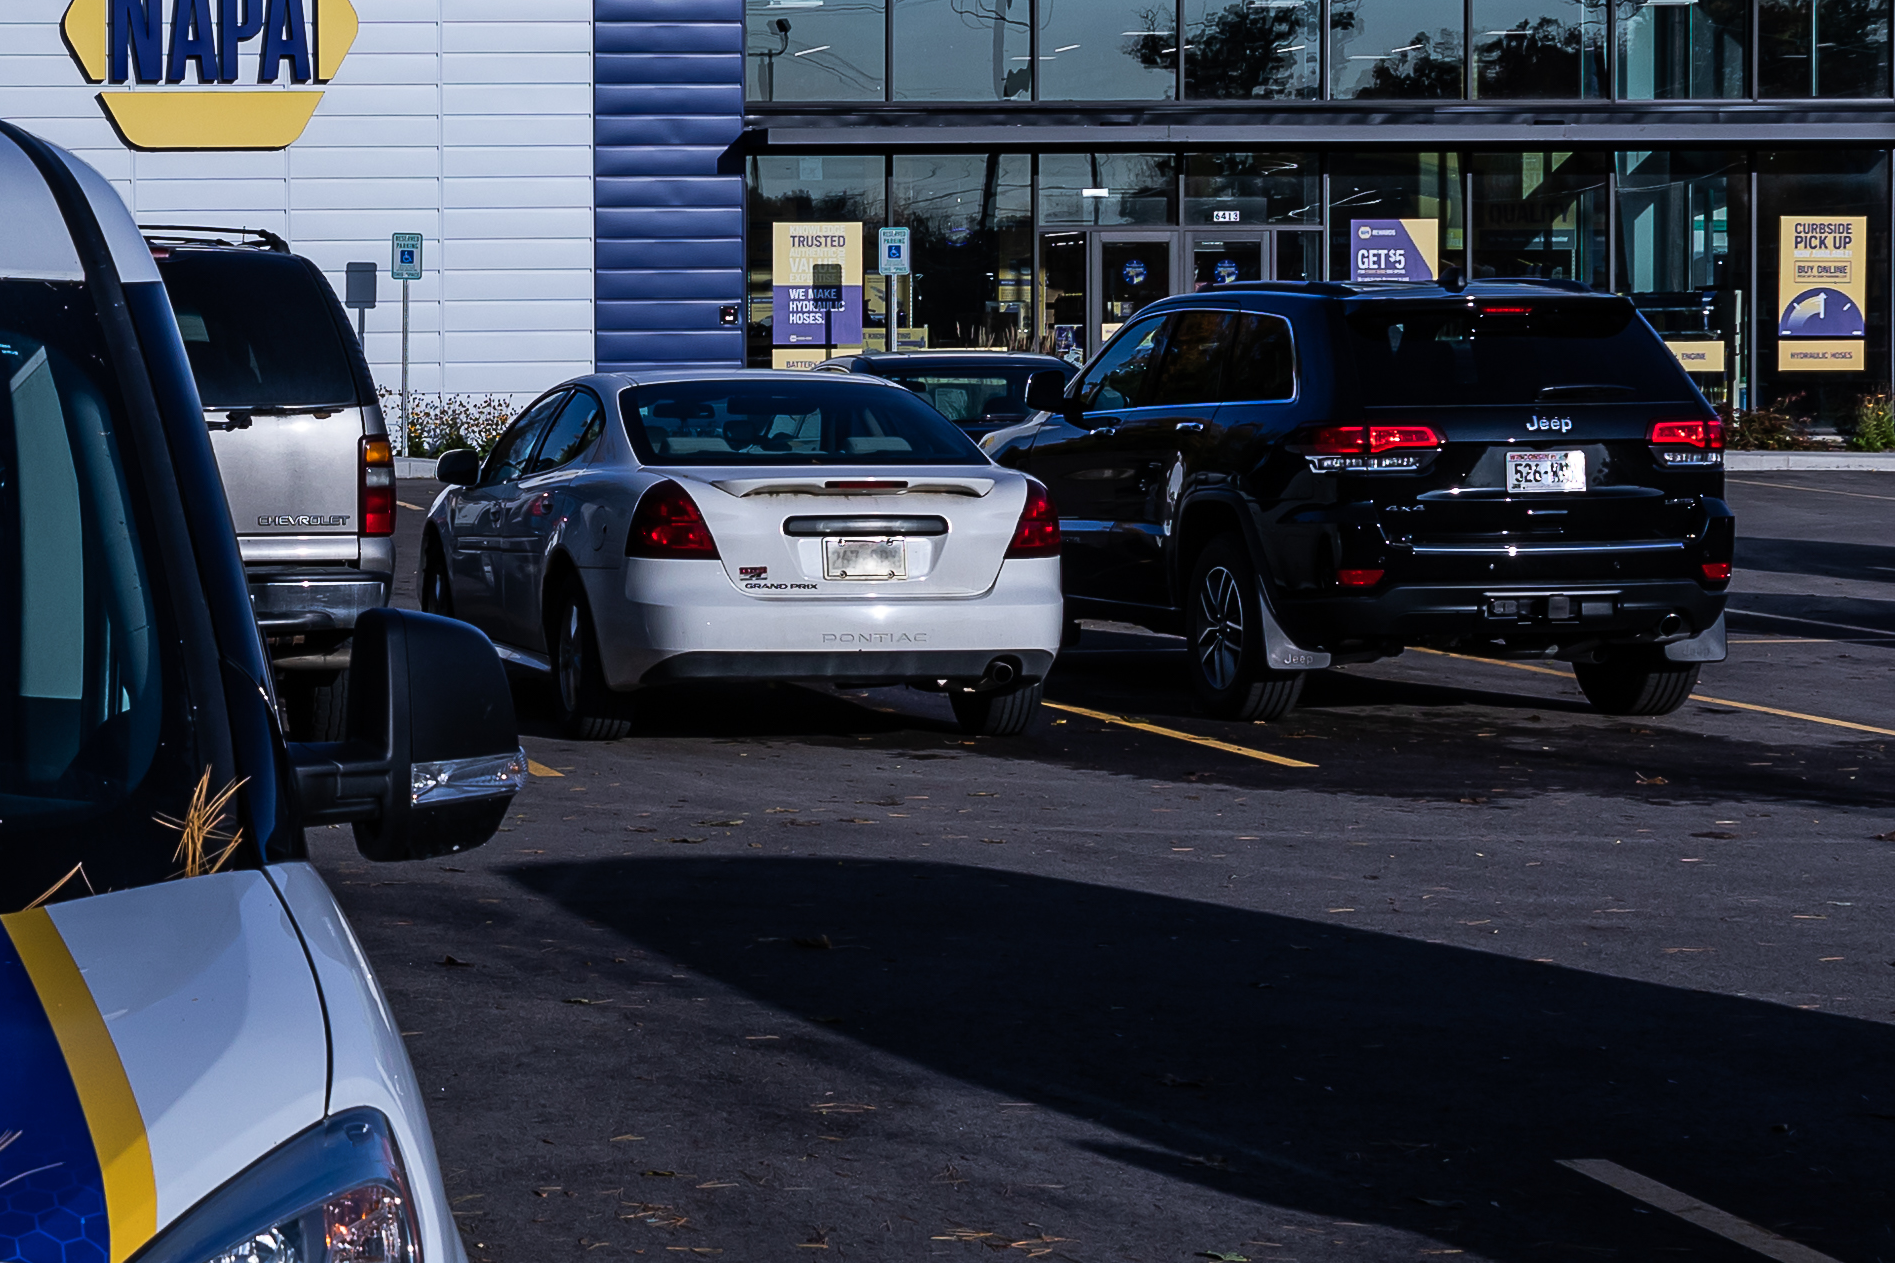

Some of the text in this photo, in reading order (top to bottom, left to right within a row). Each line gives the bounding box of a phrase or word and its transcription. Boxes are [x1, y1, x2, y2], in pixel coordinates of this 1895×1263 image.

[1215, 212, 1238, 221] 6413
[1489, 203, 1569, 225] QUALITY
[789, 225, 846, 235] KNOWLEDGE
[1794, 223, 1853, 235] CURBSIDE
[789, 235, 846, 248] TRUSTED
[1794, 236, 1853, 249] PICK UP
[789, 248, 838, 258] AUTHENTIC
[1357, 248, 1406, 269] GET $5
[789, 258, 837, 273] VALUE
[1797, 266, 1849, 274] BUY ONLINE
[789, 274, 837, 283] EXPERTISE
[789, 289, 837, 299] WE MAKE
[789, 301, 846, 312] HYDRAULIC
[789, 313, 826, 325] HOSES.
[1790, 351, 1854, 360] HYDRAULIC HOSES
[1526, 415, 1573, 433] Jeep
[257, 515, 351, 526] CHEVROLET
[821, 632, 928, 643] PONTIAC
[1283, 653, 1314, 666] Jeep
